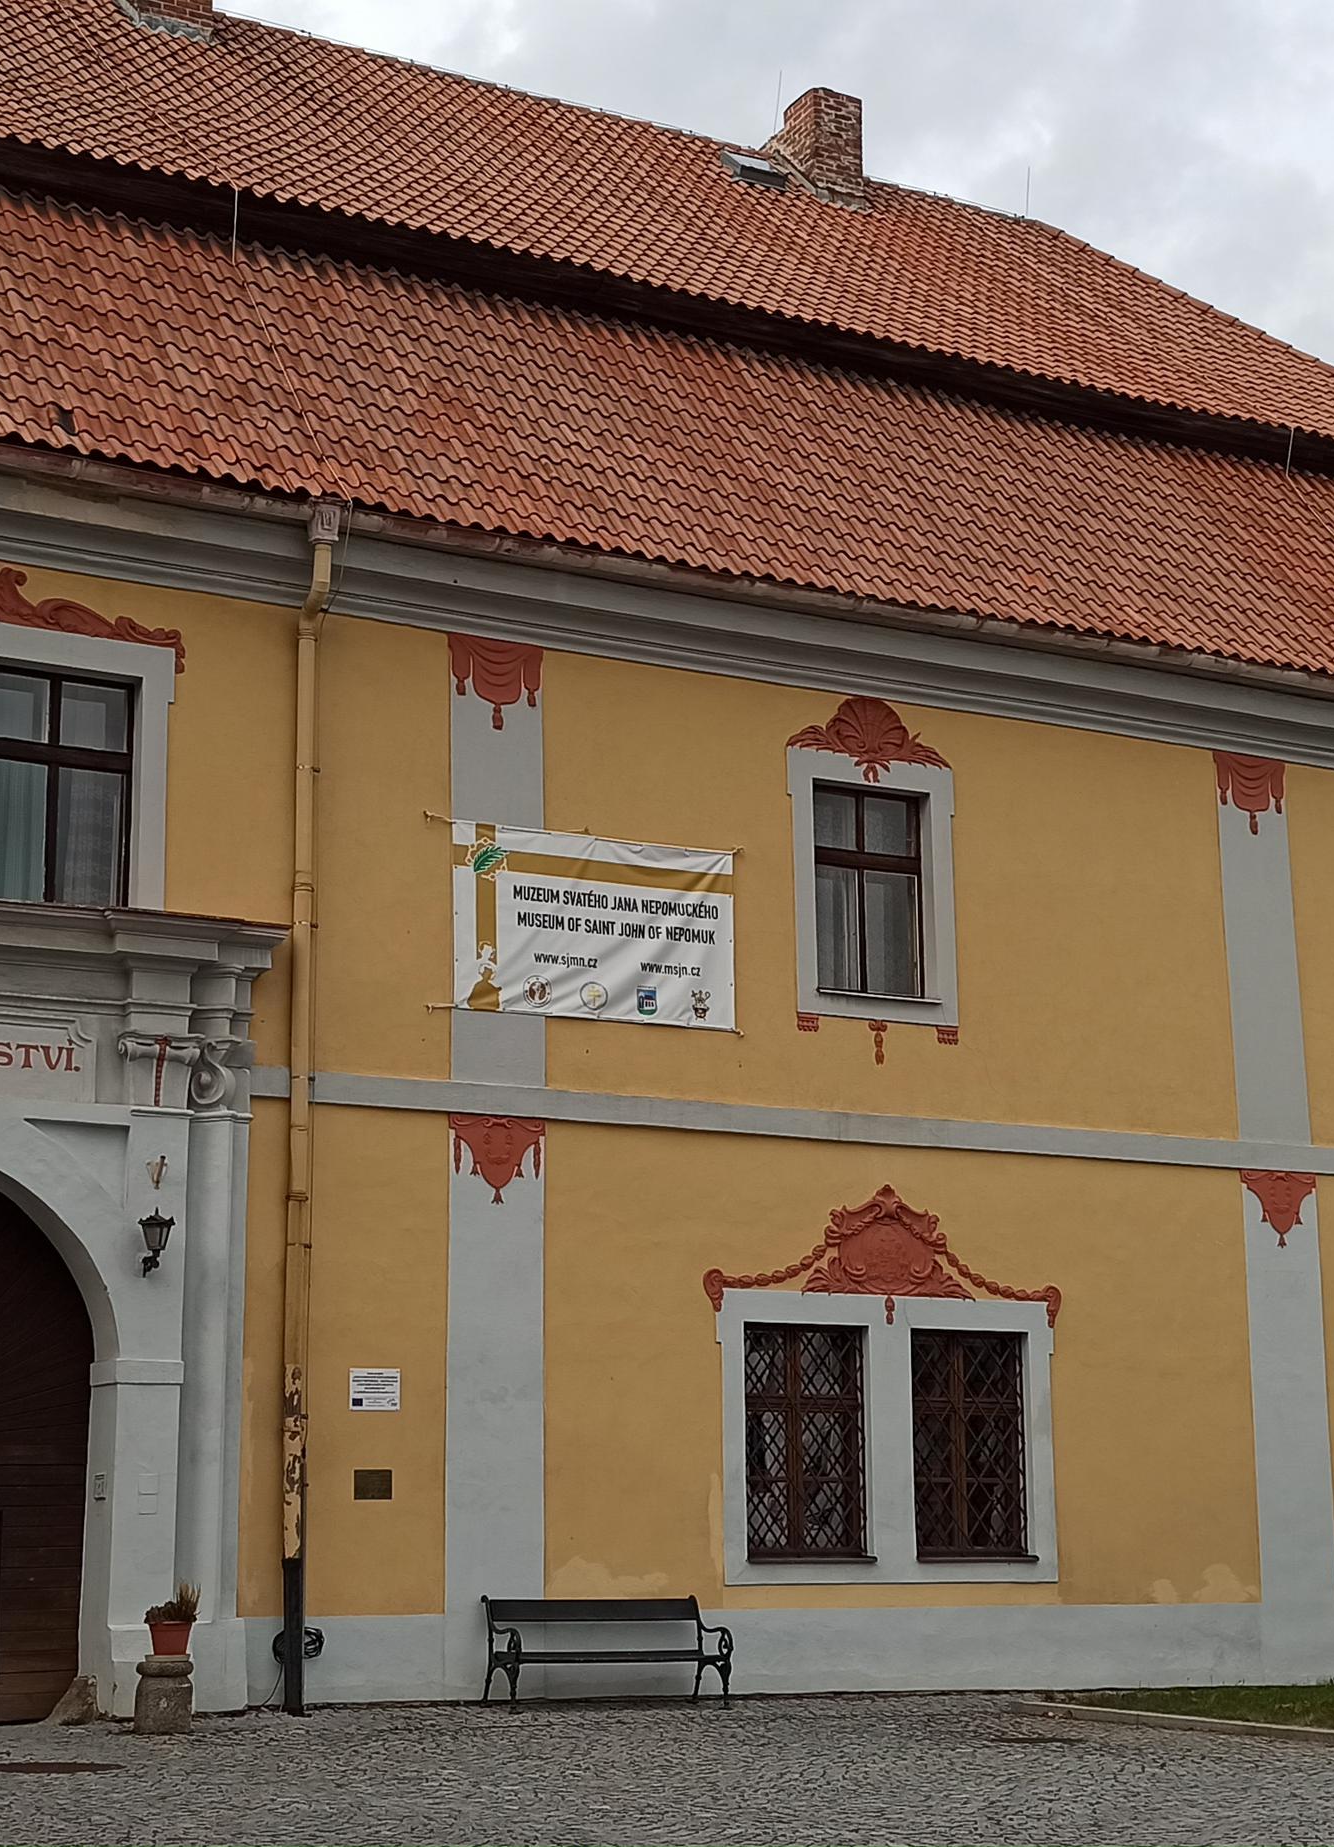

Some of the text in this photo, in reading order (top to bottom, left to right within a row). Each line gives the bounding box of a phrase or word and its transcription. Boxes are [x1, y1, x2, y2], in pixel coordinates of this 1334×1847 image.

[513, 884, 719, 919] MUZEUM SVATÉHO JANA NEPOMUCKÉHO
[517, 911, 716, 945] MUSEUM OF SAINT JOHN OF NEPOMUK
[533, 952, 598, 968] www.sjmn.cz
[640, 961, 701, 978] www.msjn.cz
